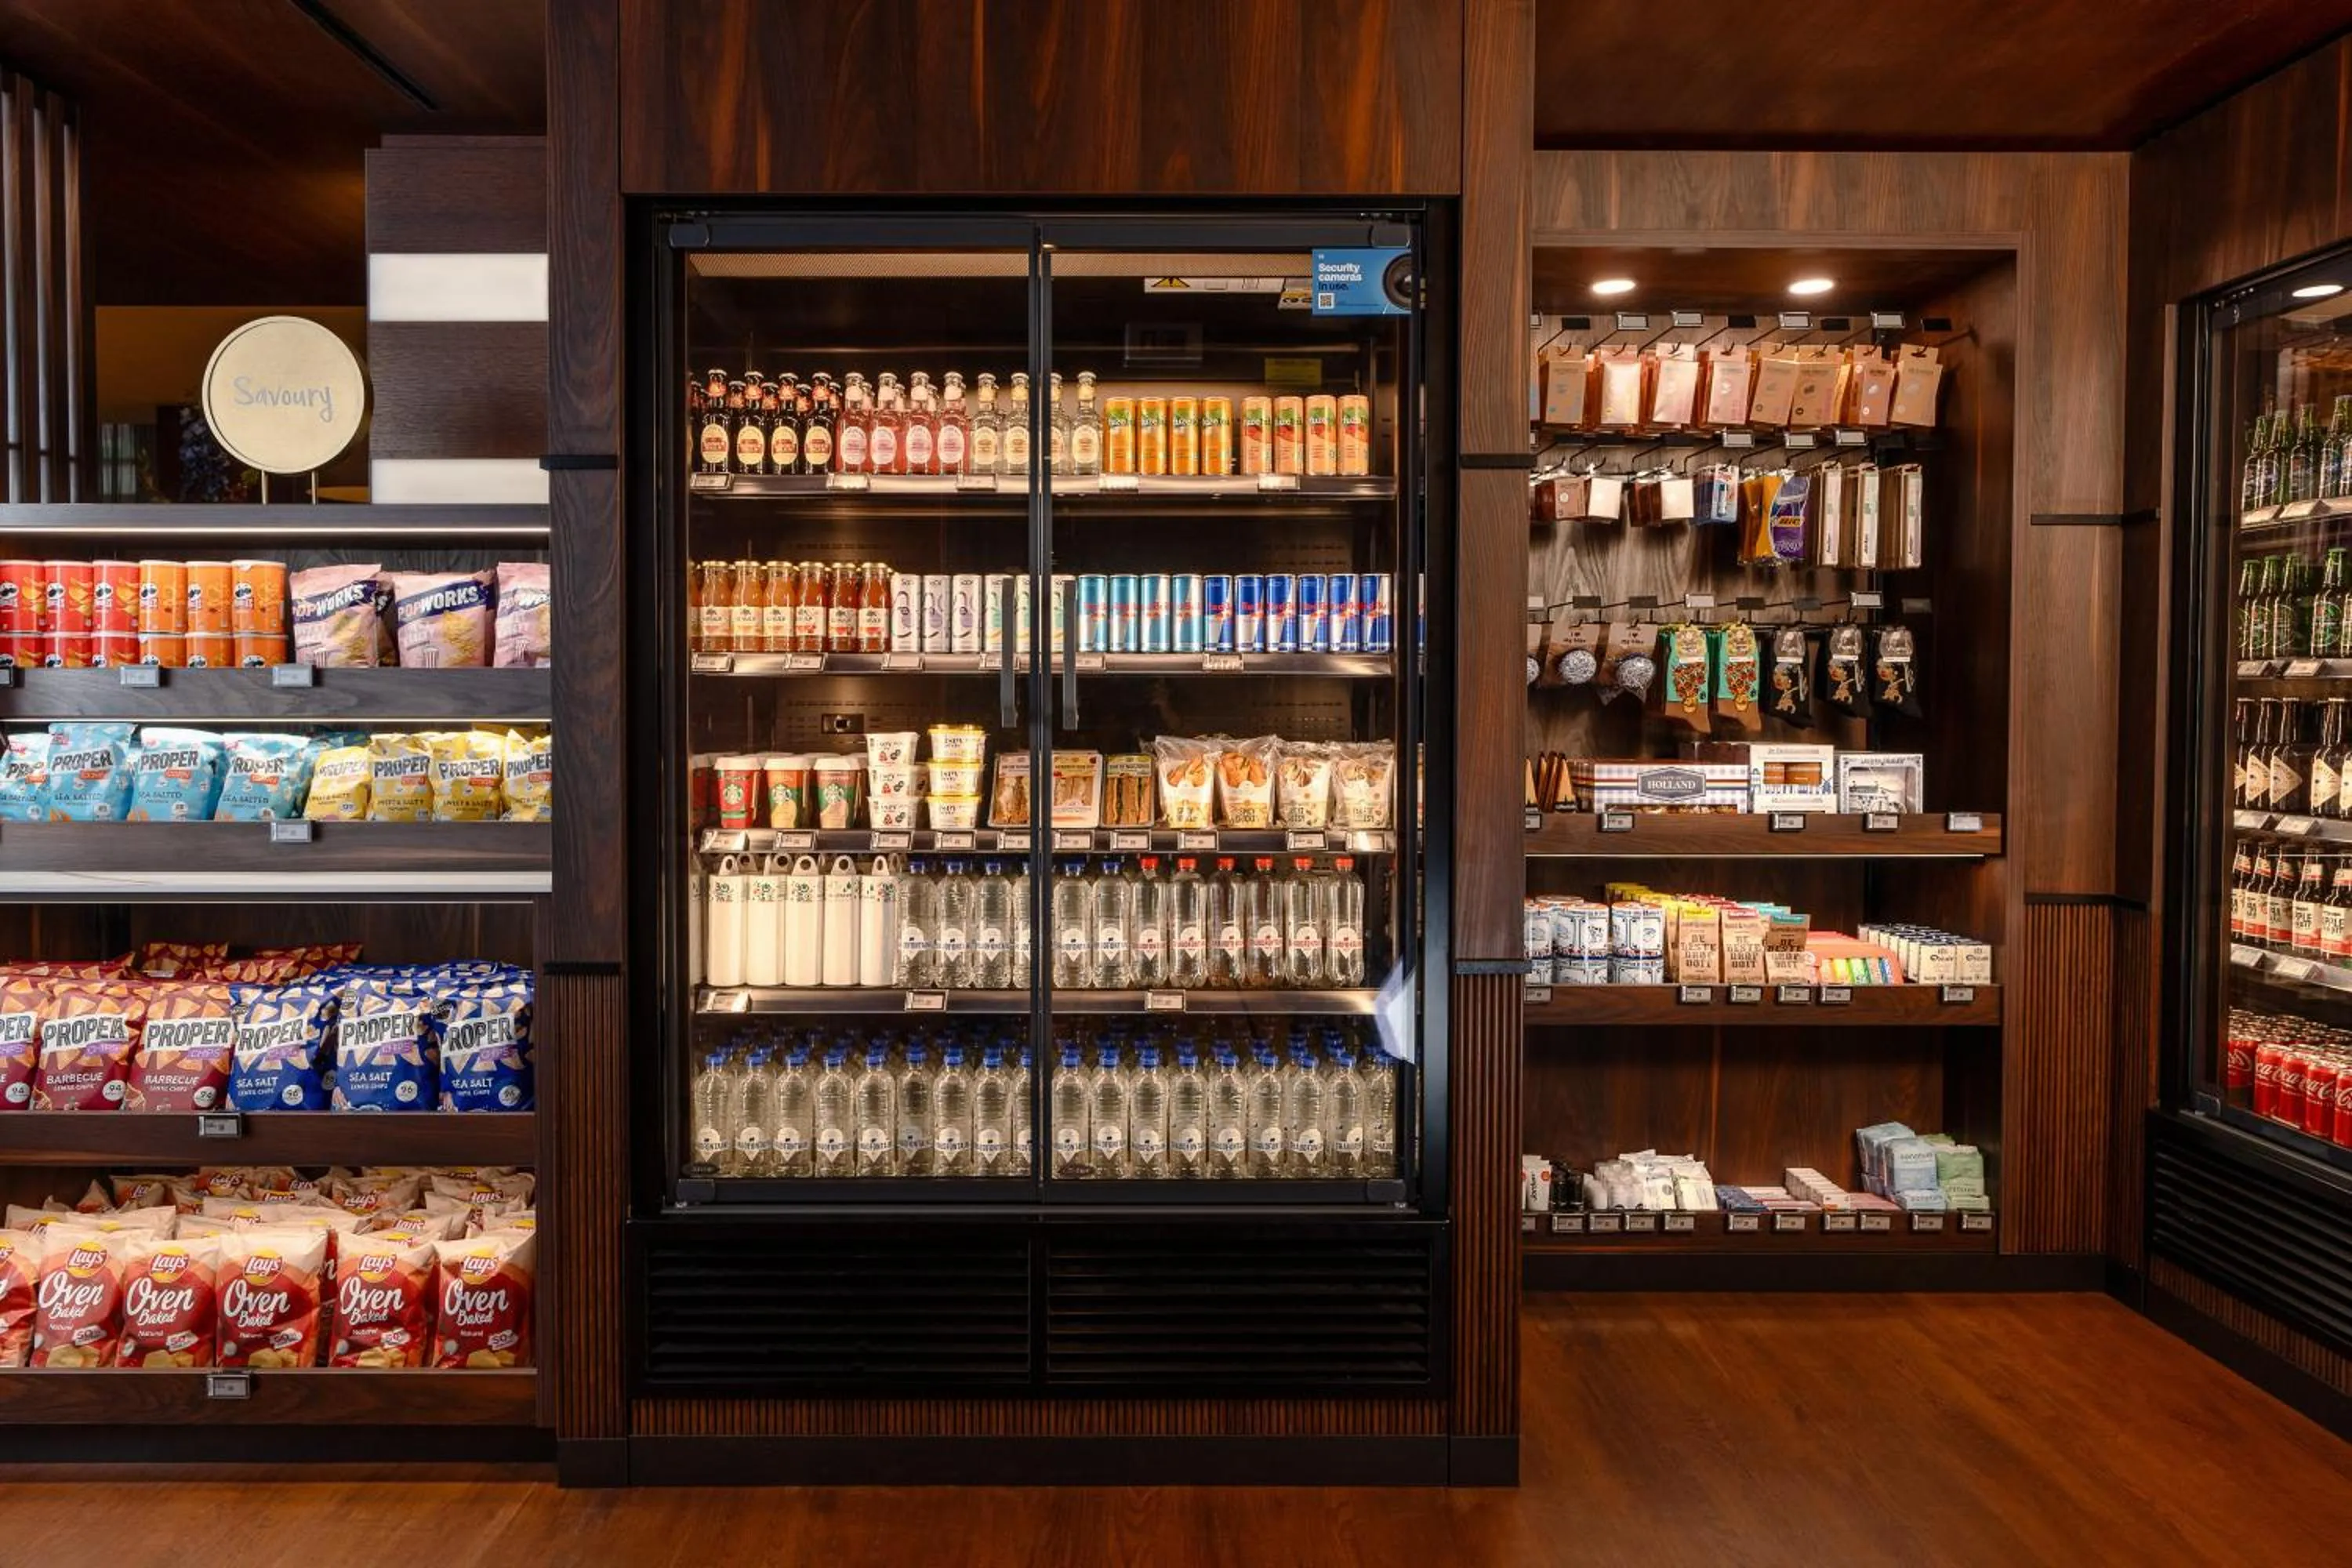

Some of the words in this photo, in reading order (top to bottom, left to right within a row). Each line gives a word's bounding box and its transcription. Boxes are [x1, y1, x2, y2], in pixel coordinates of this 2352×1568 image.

[1319, 263, 1360, 274] Security
[233, 376, 333, 423] Savoury
[397, 586, 480, 619] POPWORKS
[52, 749, 114, 772] PROPER
[140, 750, 198, 771] PROPER
[374, 755, 430, 778] PROPER
[438, 758, 499, 780] PROPER
[1646, 780, 1697, 789] HOLLAND
[43, 1017, 126, 1049] PROPER
[147, 1020, 232, 1048] PROPER
[341, 1013, 416, 1047] PROPER
[448, 1018, 514, 1051] ROPER
[190, 1049, 221, 1058] CHIPS
[46, 1072, 104, 1084] BARBECUE
[144, 1075, 199, 1085] BARBECUE
[236, 1078, 253, 1088] SEA
[255, 1076, 278, 1087] SALT
[349, 1072, 366, 1082] SEA
[368, 1072, 391, 1082] SALT
[452, 1079, 469, 1089] SEA
[470, 1077, 492, 1088] SALT
[38, 1270, 105, 1311] Oven
[125, 1277, 194, 1316] Oven
[223, 1279, 291, 1318] Oven
[340, 1276, 405, 1315] Oven
[445, 1278, 509, 1316] Oven
[49, 1302, 89, 1320] Baked
[137, 1309, 177, 1327] Baked
[238, 1309, 274, 1327] Baked
[350, 1308, 388, 1326] Baked
[456, 1309, 494, 1326] Baked
